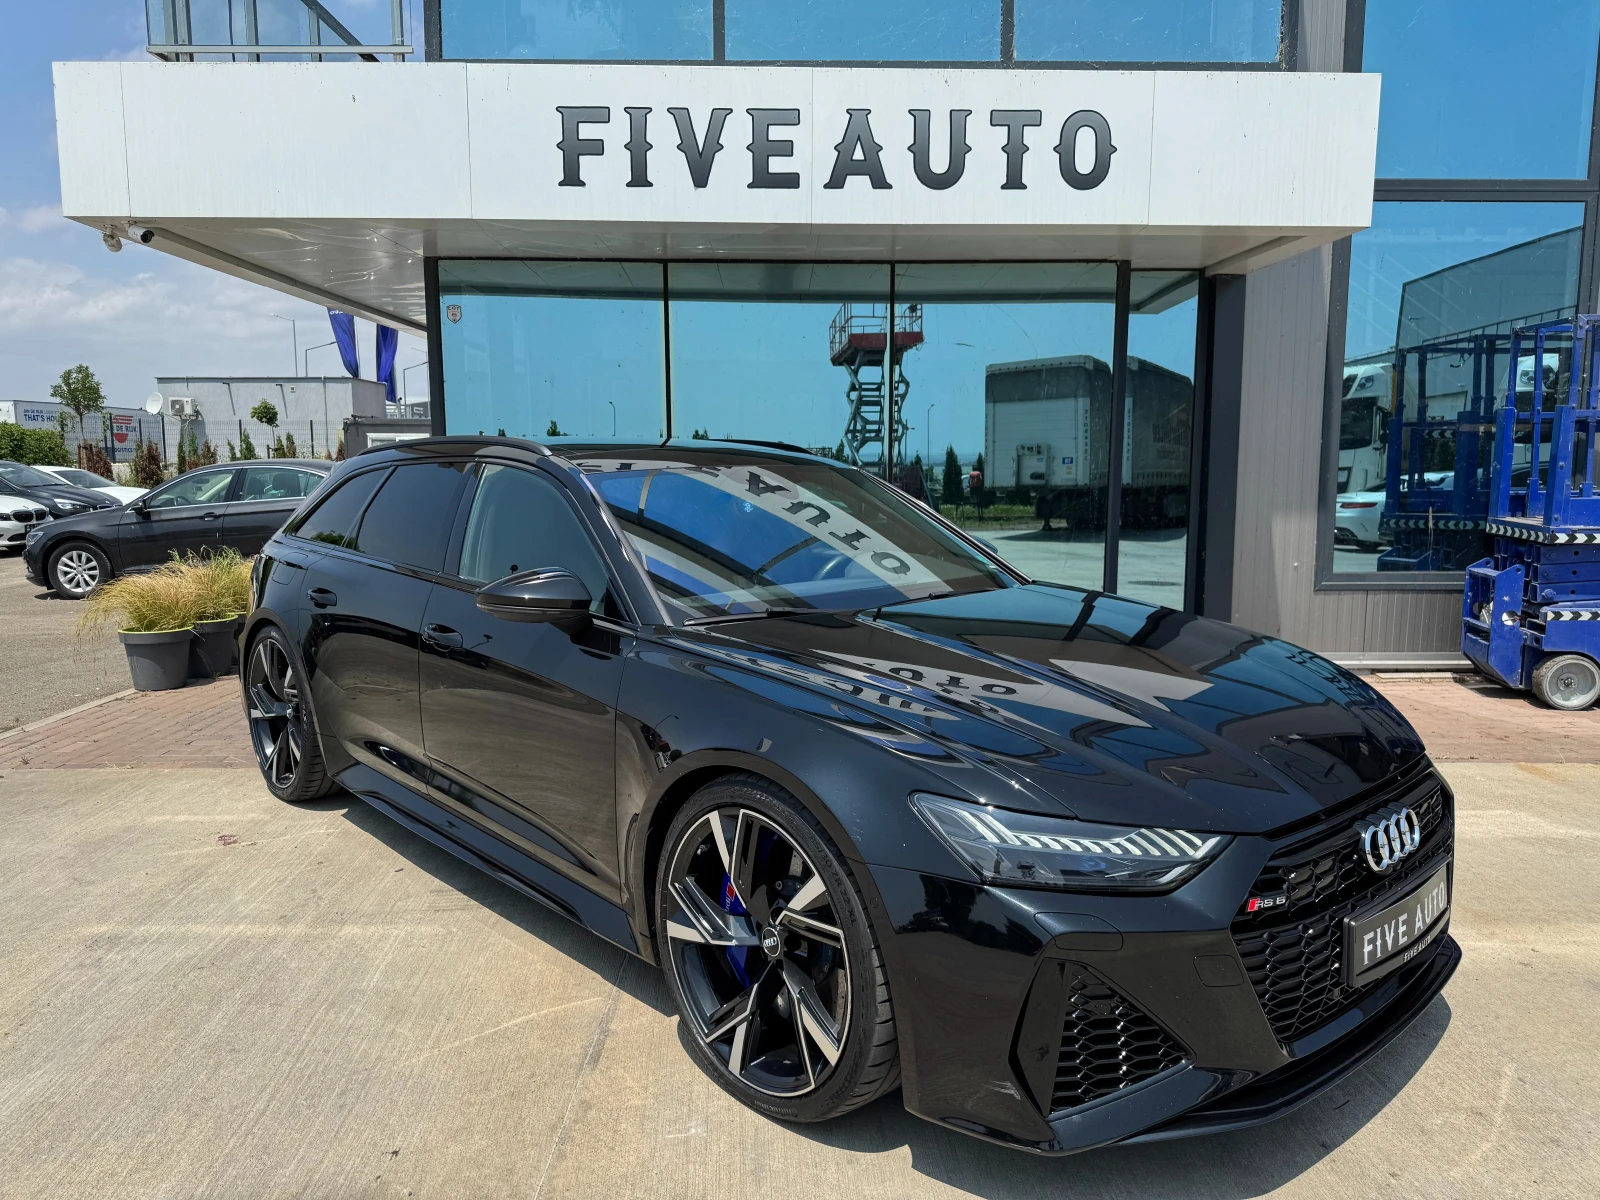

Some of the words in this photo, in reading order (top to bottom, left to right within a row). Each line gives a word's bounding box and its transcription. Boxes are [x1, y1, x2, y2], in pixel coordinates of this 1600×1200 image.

[23, 413, 45, 422] THAT'S
[1253, 898, 1274, 910] RS
[1363, 912, 1408, 965] FIVE
[1414, 882, 1445, 935] AUTO
